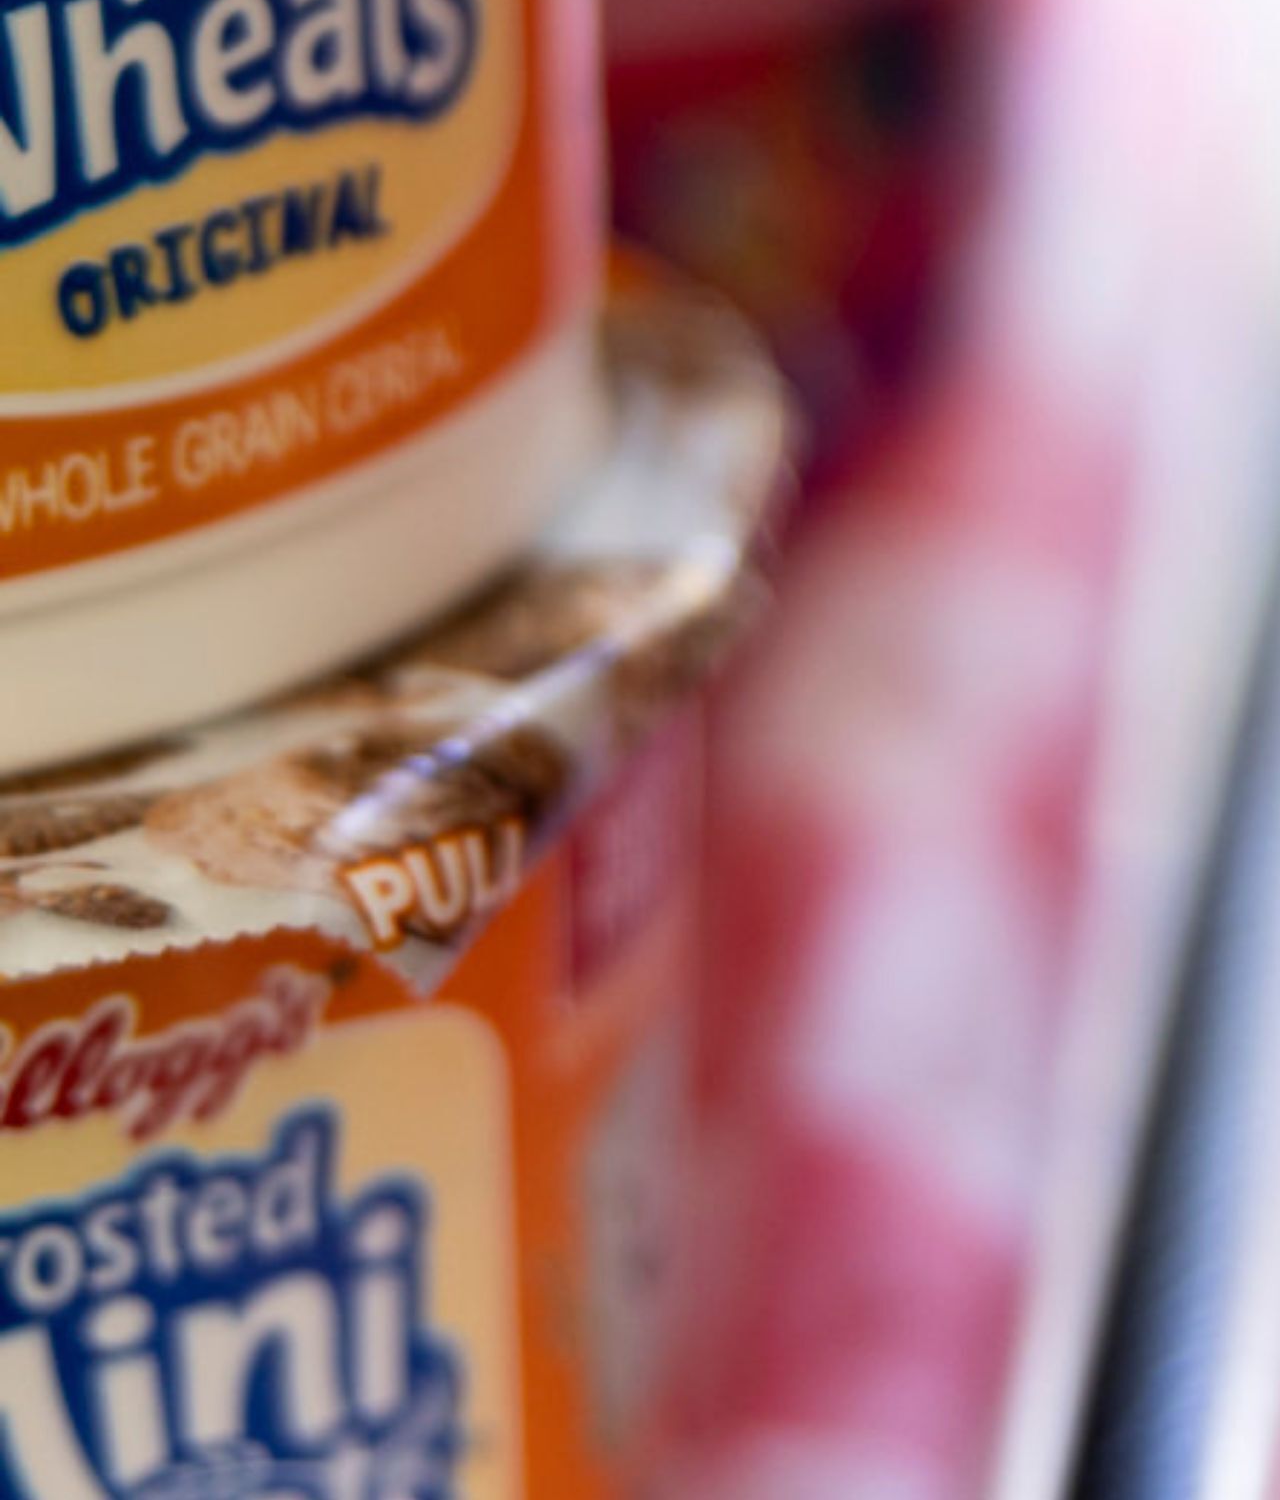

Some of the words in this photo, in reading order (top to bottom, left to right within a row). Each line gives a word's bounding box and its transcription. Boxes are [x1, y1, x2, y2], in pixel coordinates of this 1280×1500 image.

[57, 162, 391, 338] ORIGINAL
[172, 382, 320, 490] GRAIN
[0, 975, 325, 1144] llogg's
[0, 1122, 318, 1312] osted
